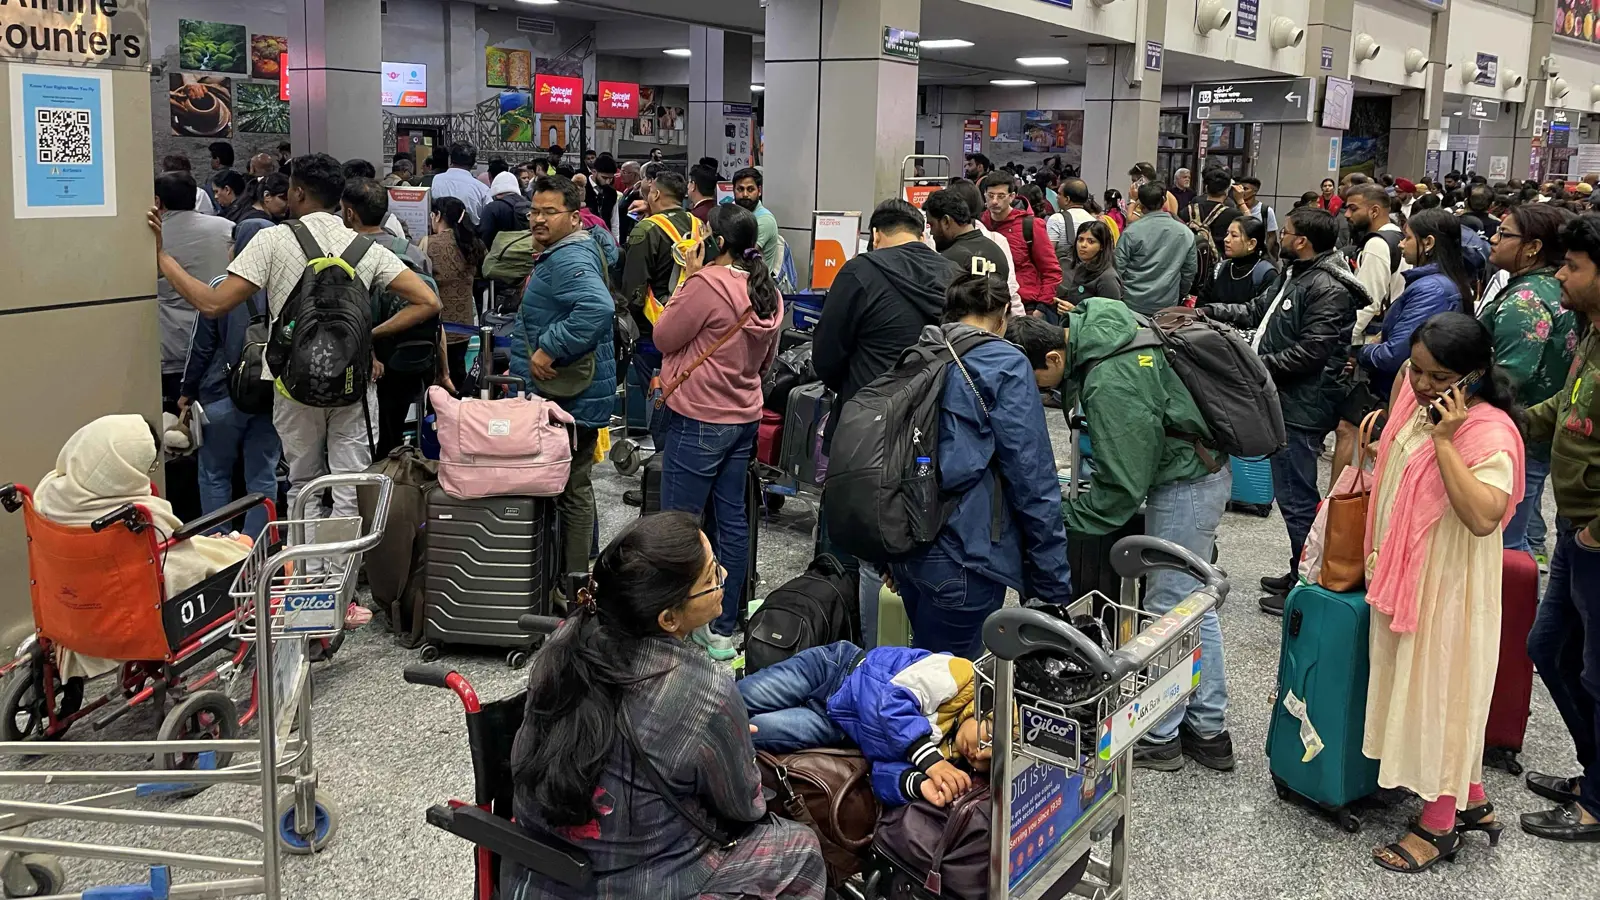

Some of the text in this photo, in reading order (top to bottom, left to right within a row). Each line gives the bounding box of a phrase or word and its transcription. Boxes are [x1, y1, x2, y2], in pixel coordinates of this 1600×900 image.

[0, 21, 140, 58] ounters
[181, 594, 206, 624] 01
[1138, 704, 1149, 720] J&K
[1030, 767, 1038, 787] is
[1010, 817, 1022, 830] rivate
[1022, 806, 1035, 820] sector
[1035, 795, 1047, 810] banks
[1051, 784, 1061, 795] India
[1030, 796, 1034, 805] of
[1041, 781, 1053, 795] oldest
[1009, 796, 1062, 850] Serving you since 1938
